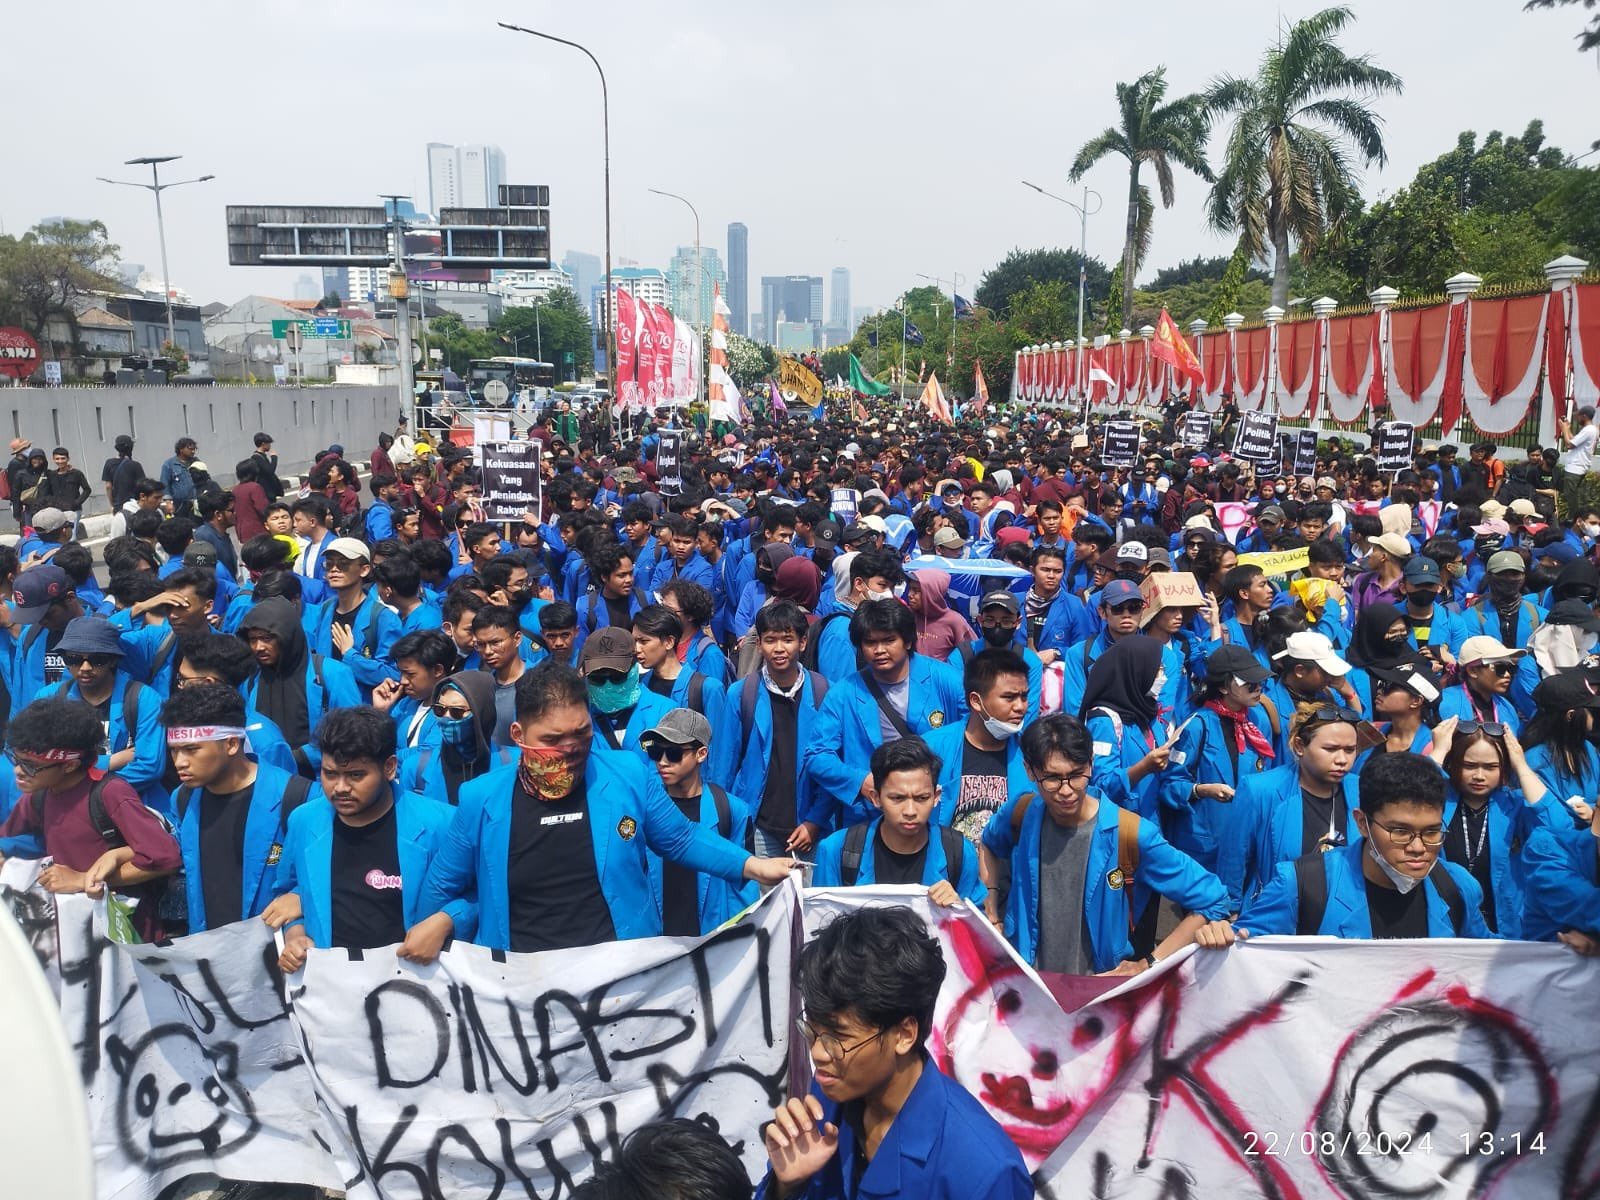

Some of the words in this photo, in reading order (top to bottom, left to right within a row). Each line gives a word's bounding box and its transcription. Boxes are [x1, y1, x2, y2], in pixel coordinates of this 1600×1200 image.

[1245, 427, 1271, 440] Politik
[496, 443, 525, 454] Lawan
[486, 458, 536, 469] Kekuasaan
[499, 474, 523, 486] Yang
[490, 490, 533, 500] Menindas
[496, 505, 529, 517] Rakyat
[364, 922, 774, 1096] DINASTI
